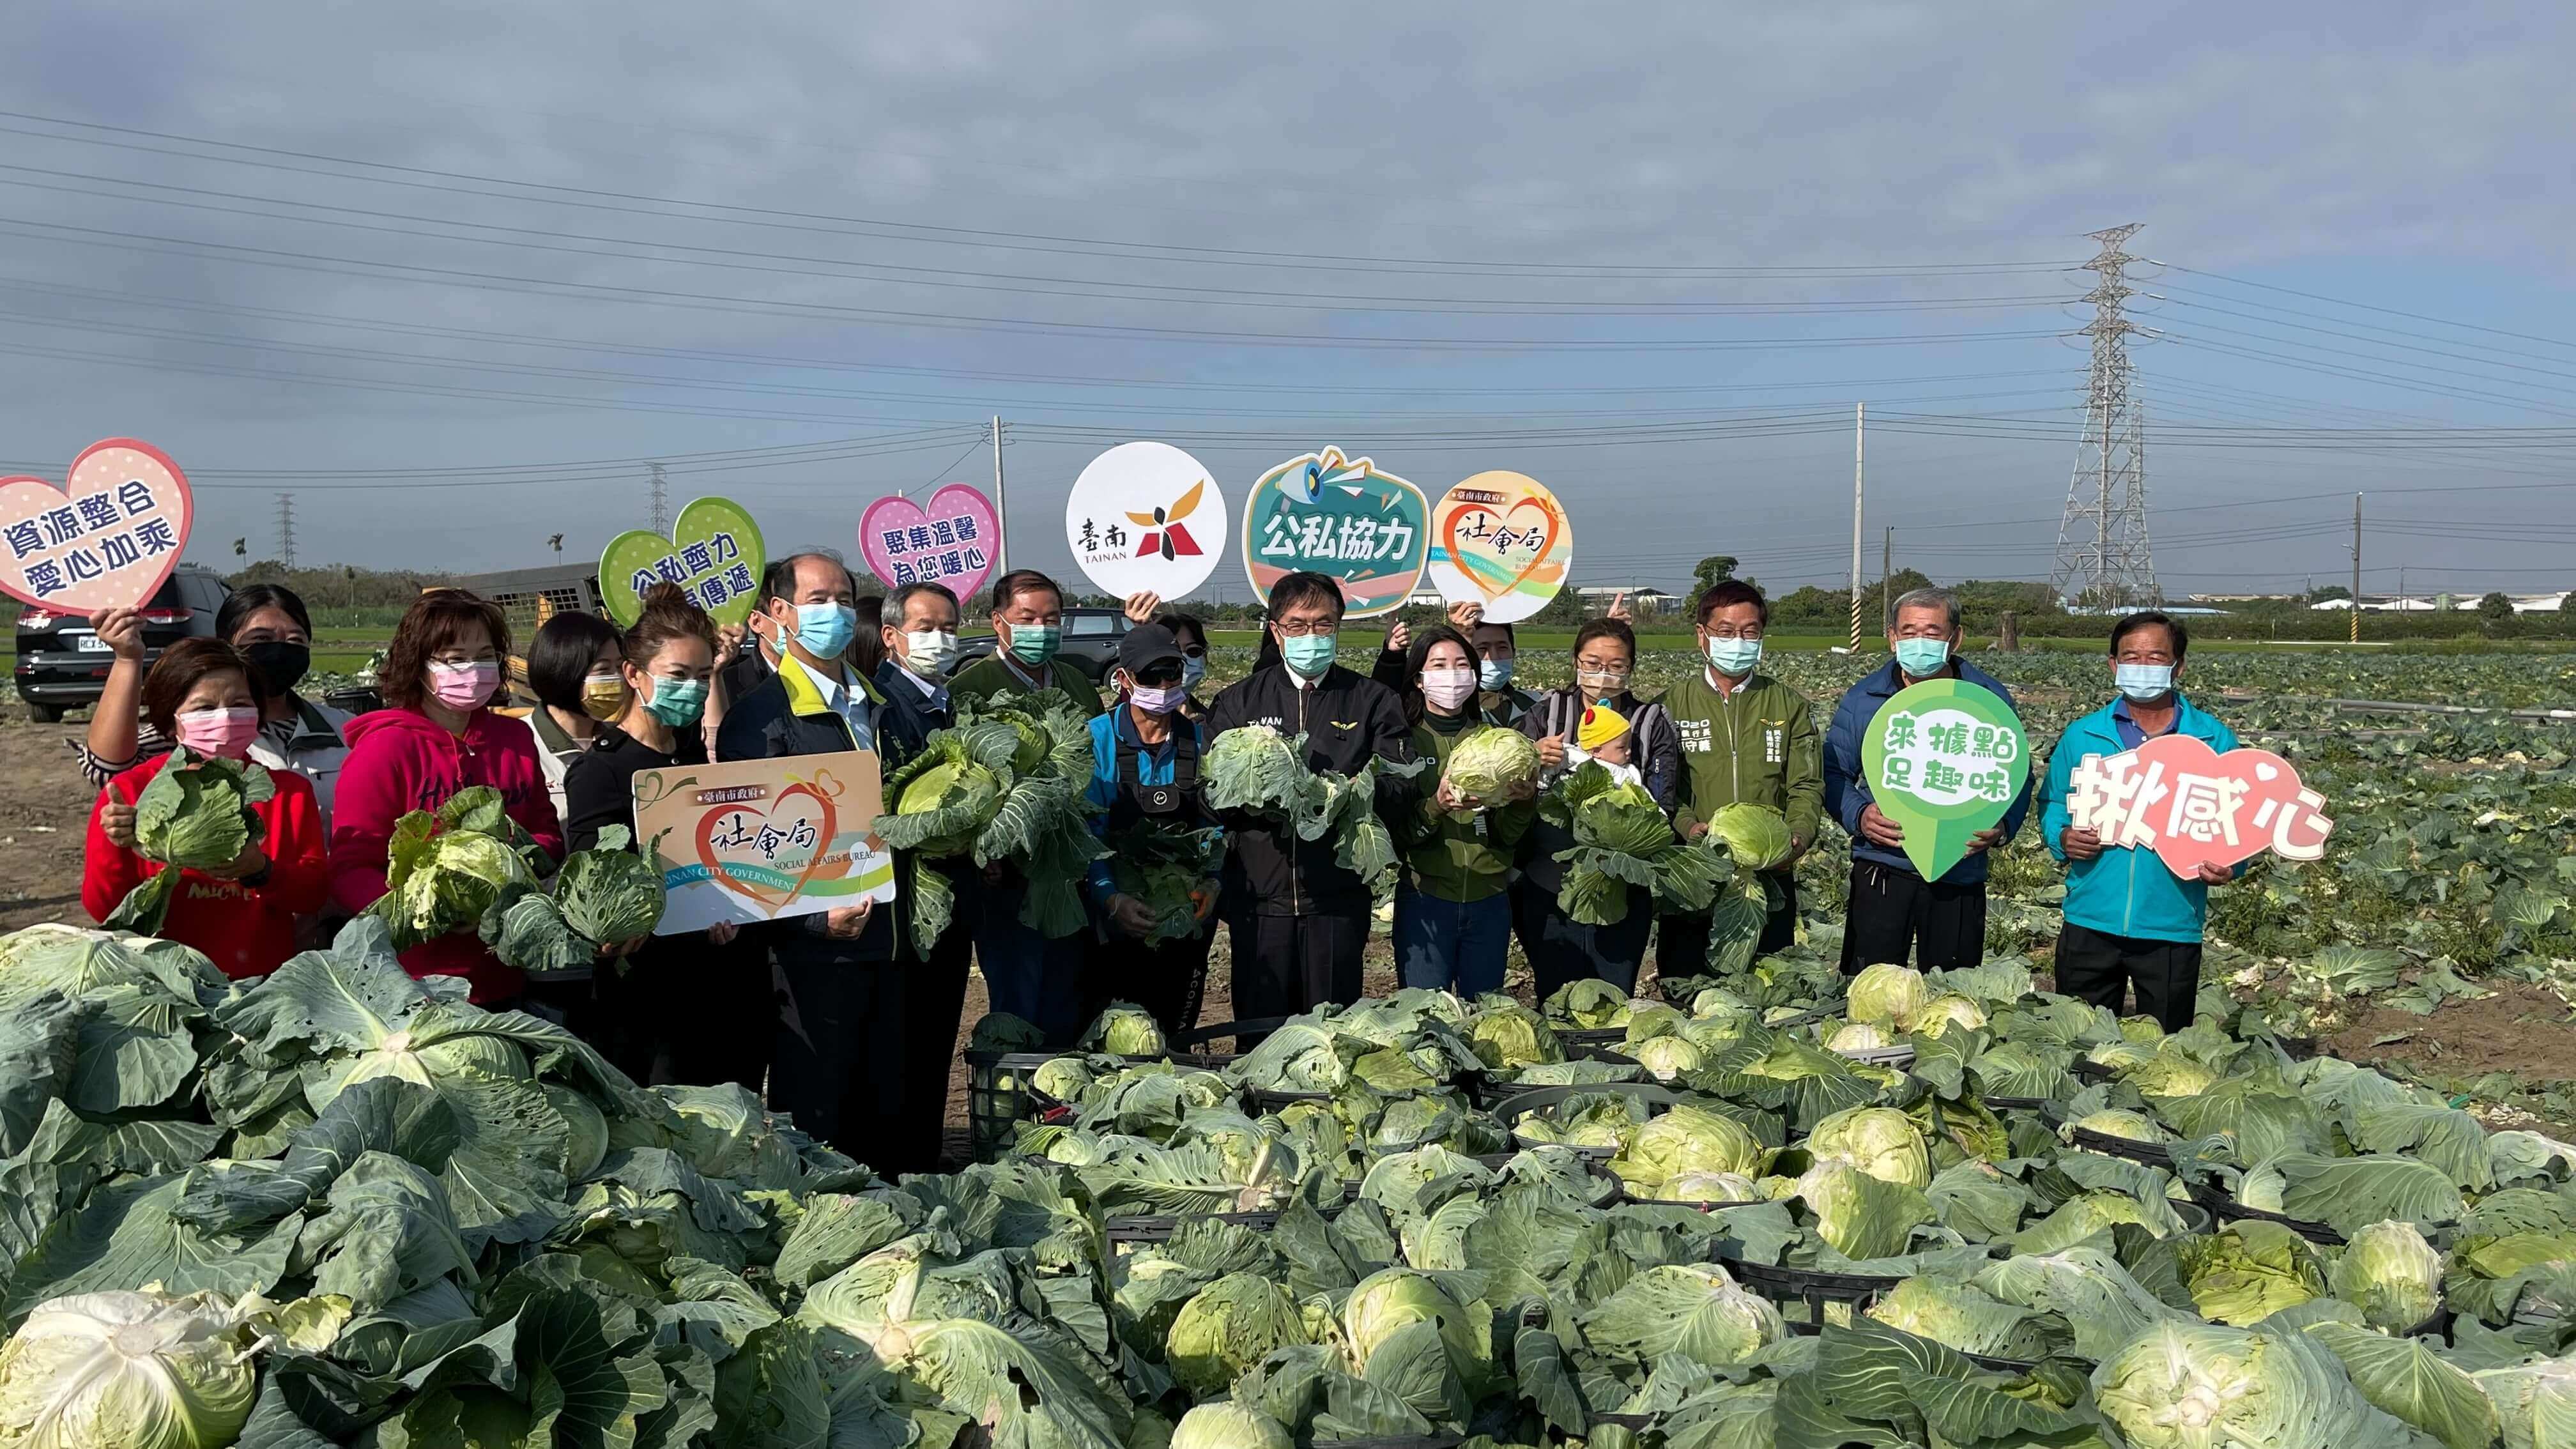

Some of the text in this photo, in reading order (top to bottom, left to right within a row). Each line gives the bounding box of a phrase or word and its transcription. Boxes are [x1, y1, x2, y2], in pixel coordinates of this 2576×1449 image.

[3, 480, 155, 559] 資源整合
[883, 516, 977, 555] 聚集溫馨
[1078, 518, 1127, 552] 臺南
[1261, 514, 1413, 561] 公私協力
[1456, 513, 1545, 555] 社會局
[24, 517, 178, 598] 愛心加乘
[892, 547, 986, 586] 為您暖心
[1084, 551, 1127, 564] TAINAN
[1887, 714, 2013, 760] 來據點
[703, 786, 758, 803] 臺南市政府
[1885, 757, 2008, 800] 足趣味
[2067, 751, 2333, 859] 揪感心
[710, 813, 816, 861] 社會局
[698, 866, 723, 877] CITY
[725, 866, 798, 891] GOVERNMENT
[774, 850, 876, 870] SOCIAL AFFAIRS BUREAU
